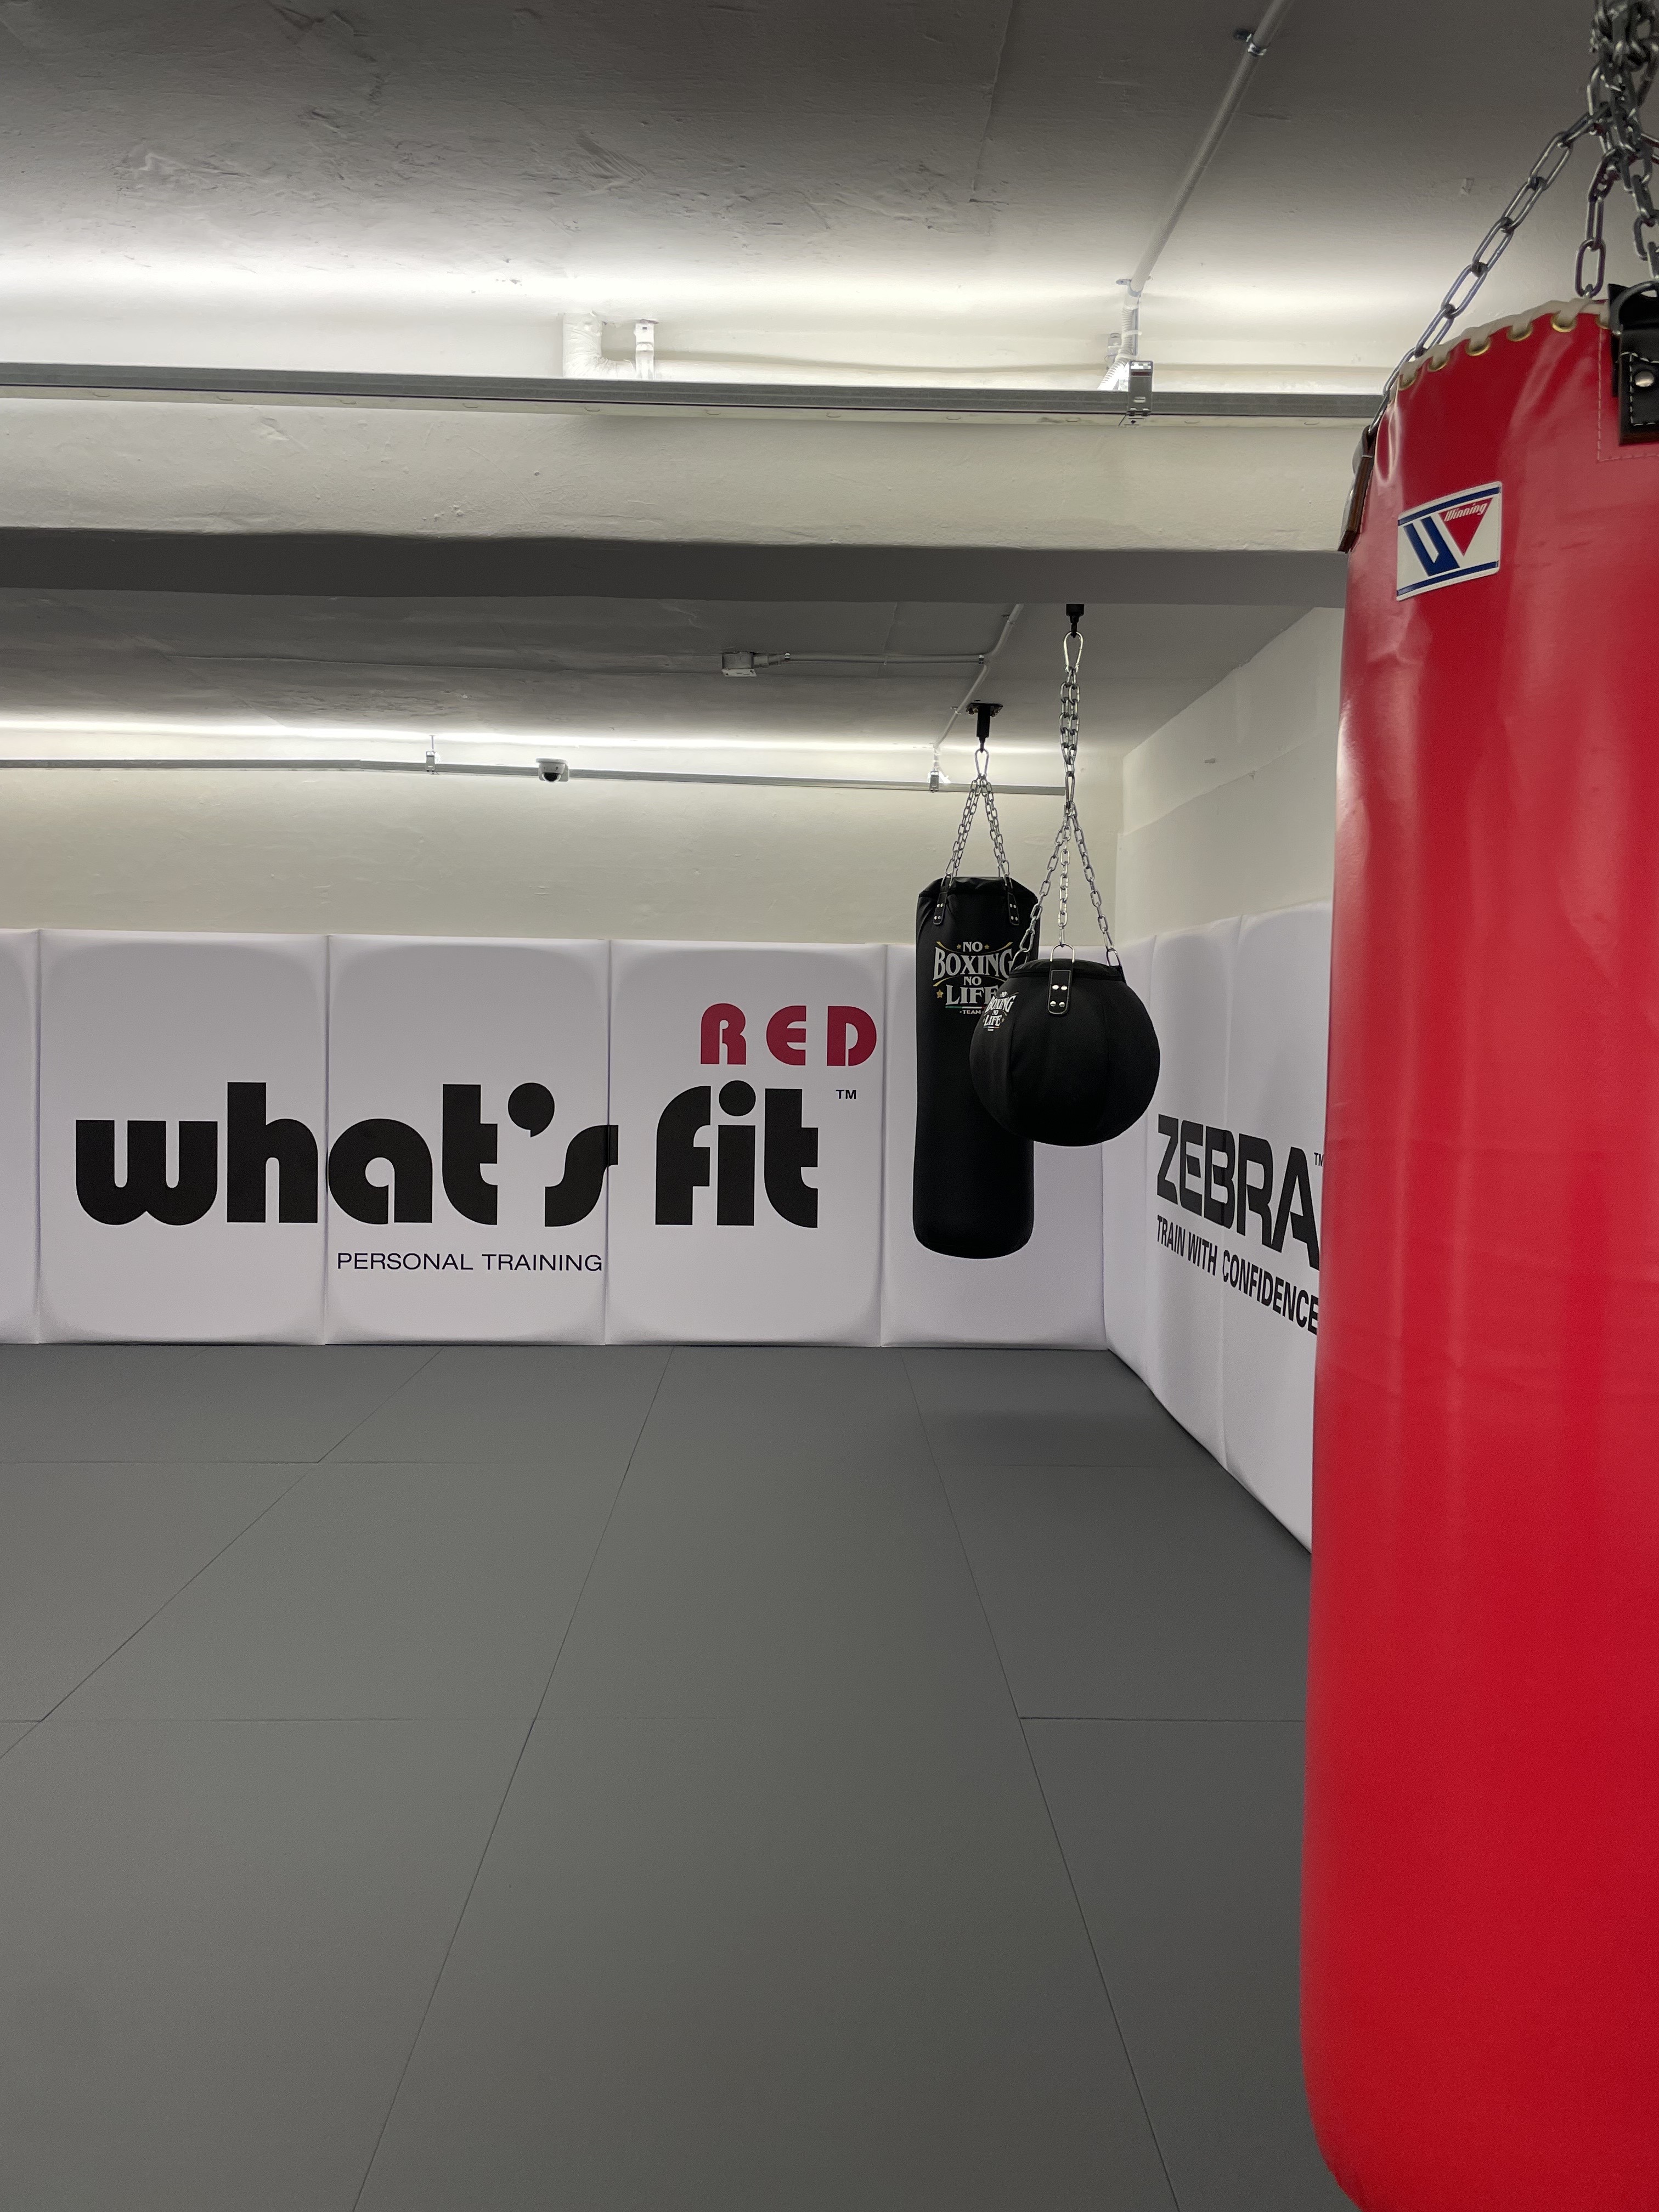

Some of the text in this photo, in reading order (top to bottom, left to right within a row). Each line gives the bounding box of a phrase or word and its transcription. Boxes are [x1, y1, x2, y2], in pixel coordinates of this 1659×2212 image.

[1444, 503, 1488, 522] Winning
[962, 941, 983, 952] NO
[933, 947, 1013, 980] BOXING
[963, 976, 982, 986] NO
[984, 995, 1017, 1013] BOXING
[984, 1014, 1002, 1026] LIFE
[701, 1003, 877, 1066] RED
[655, 1080, 819, 1228] fit
[1157, 1114, 1320, 1271] ZEBRA
[337, 1252, 602, 1271] PERSONAL TRAINING
[1157, 1215, 1319, 1336] TRAIN WITH CONFIDENCE
